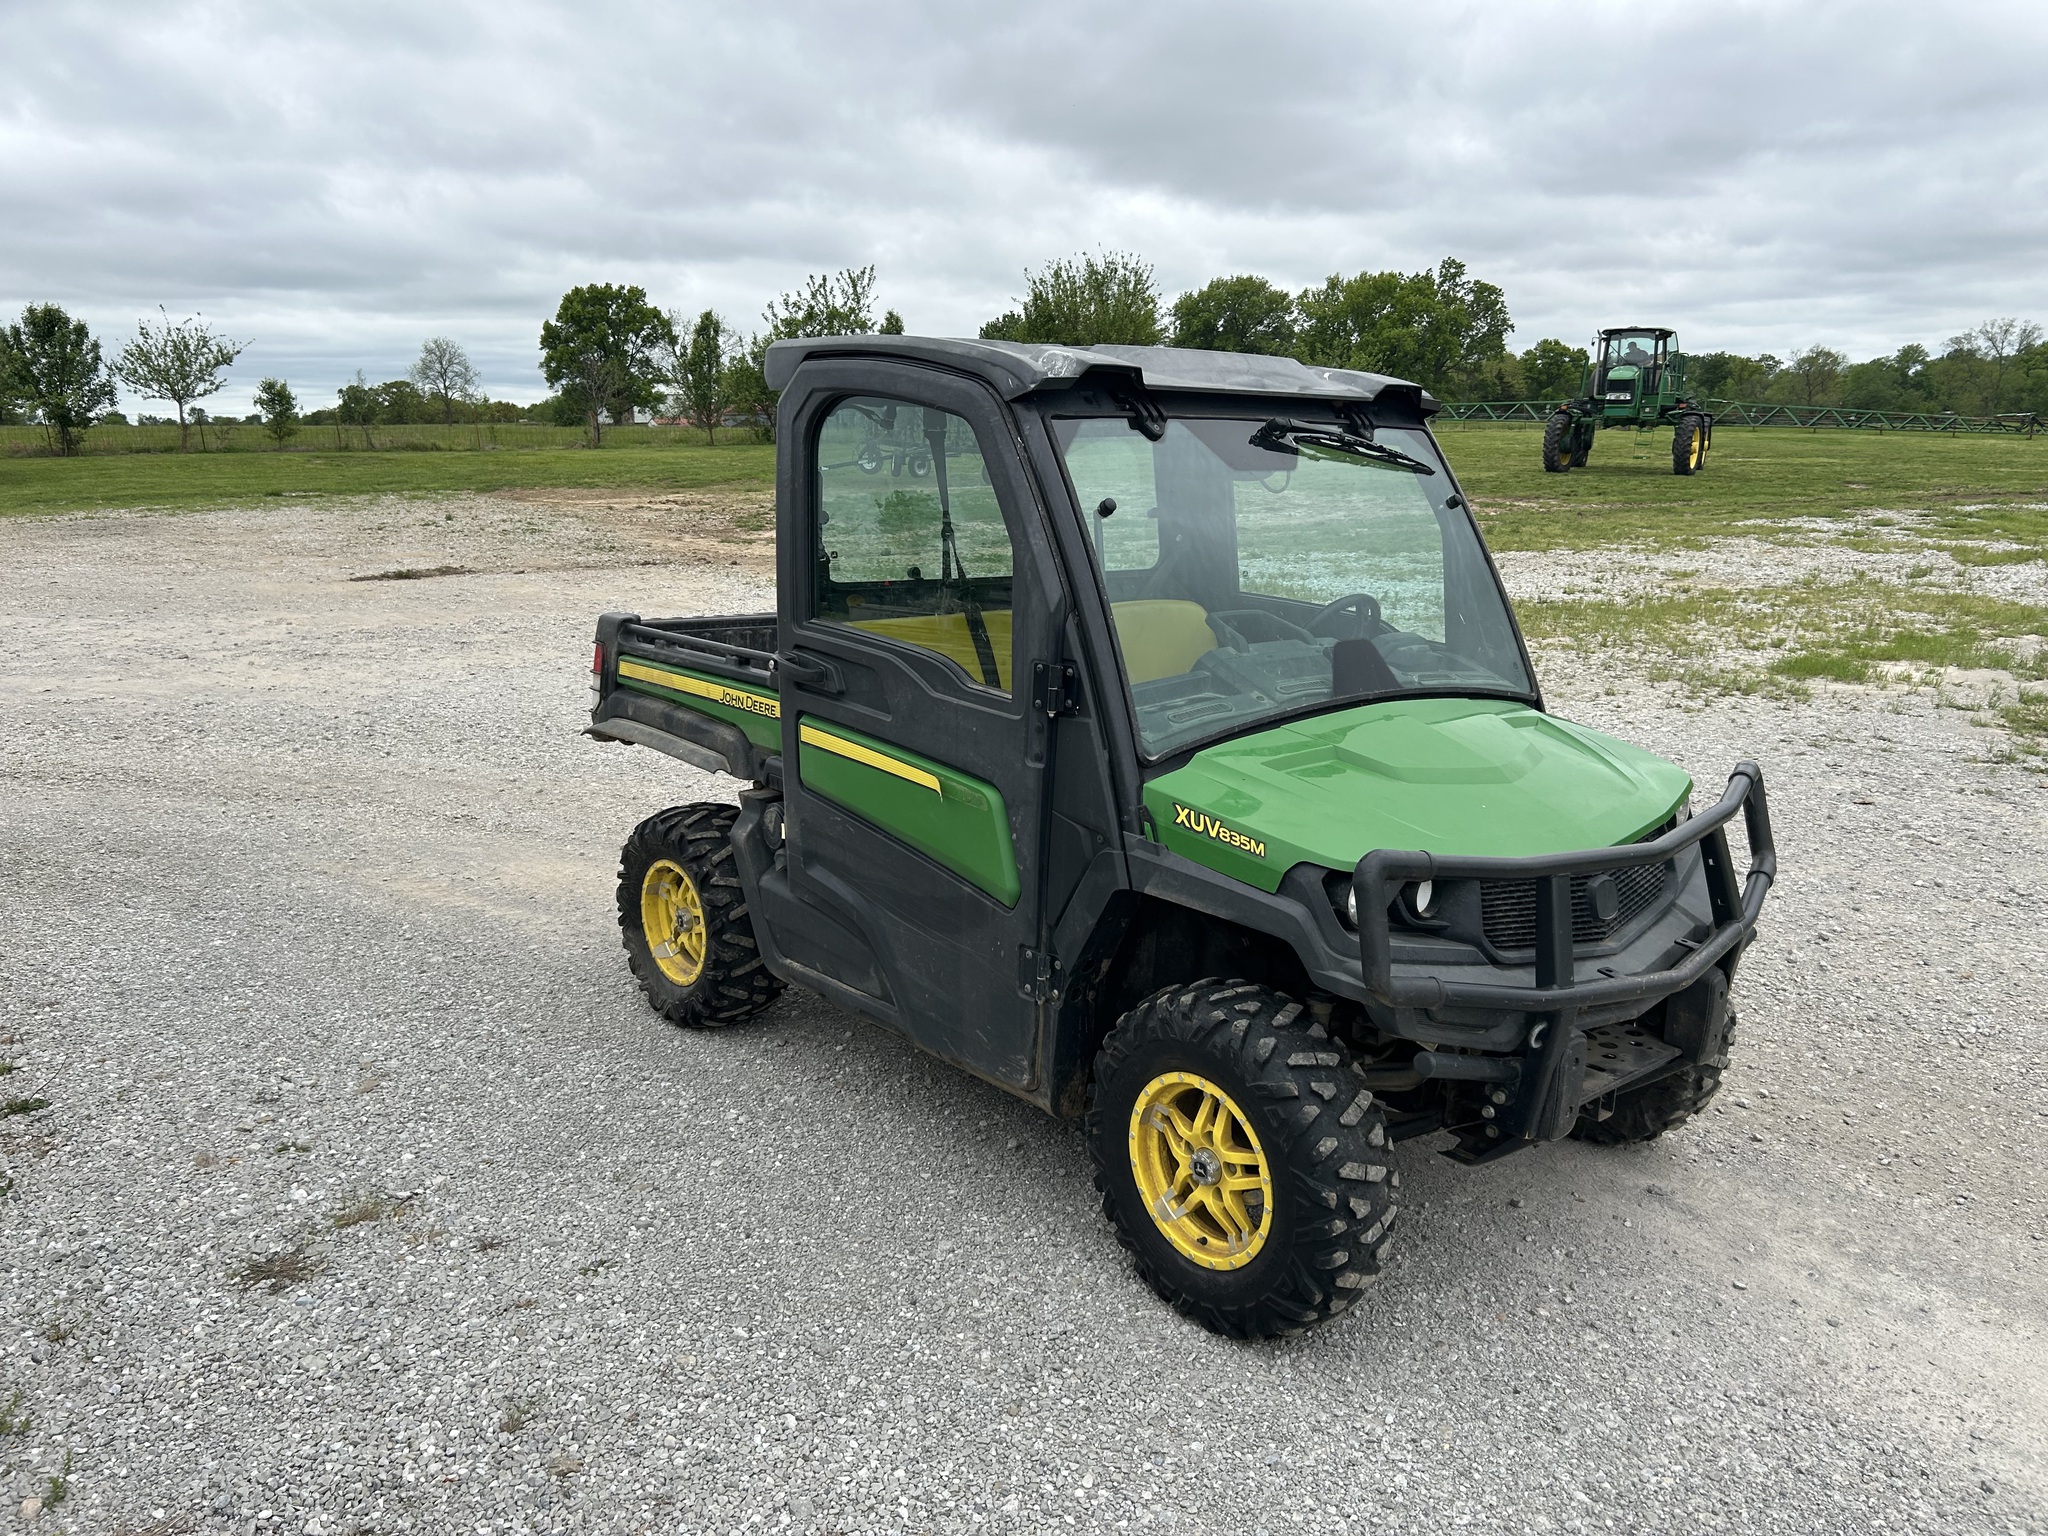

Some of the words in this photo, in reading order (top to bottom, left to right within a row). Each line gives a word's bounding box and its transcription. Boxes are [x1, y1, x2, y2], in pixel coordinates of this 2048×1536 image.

[719, 689, 744, 707] JOHN
[745, 695, 777, 716] DEERE
[1174, 803, 1265, 857] XUV835M
